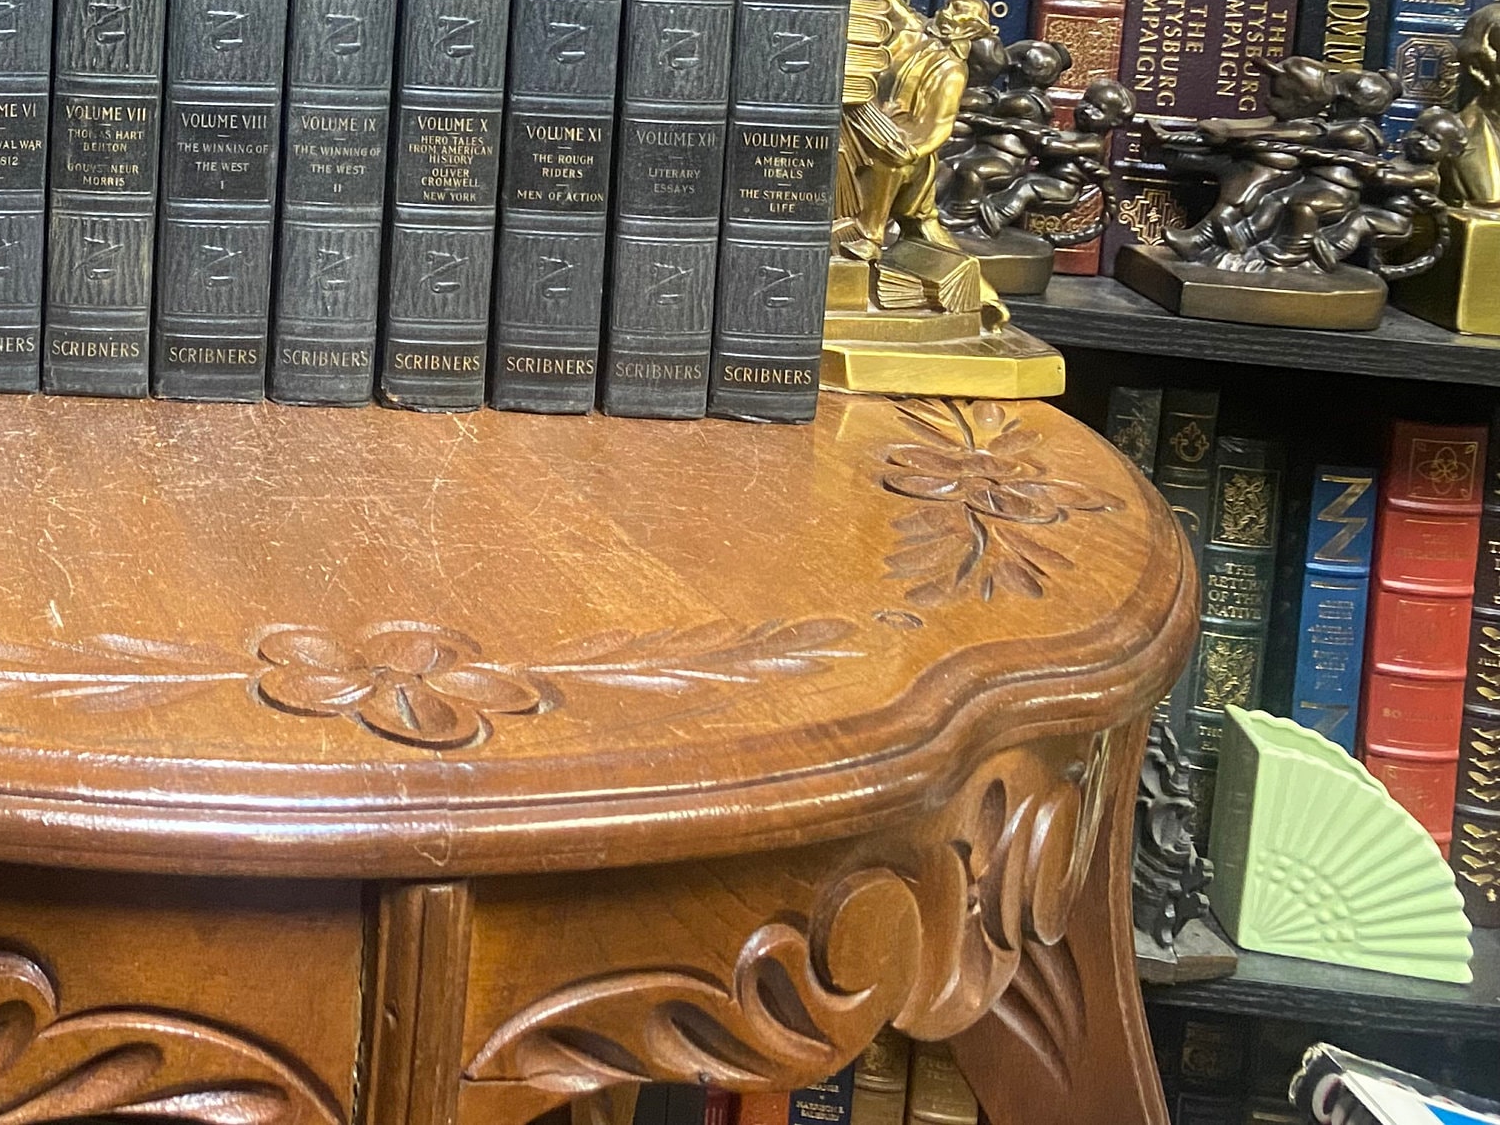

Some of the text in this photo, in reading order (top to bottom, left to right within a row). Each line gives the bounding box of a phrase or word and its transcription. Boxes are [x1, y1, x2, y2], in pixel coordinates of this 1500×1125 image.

[1185, 4, 1208, 53] THE
[1266, 10, 1288, 57] THE
[22, 103, 37, 118] VI
[19, 140, 43, 151] WAR
[742, 132, 829, 151] VOLUME XIII
[754, 156, 815, 168] AMERICAN
[763, 168, 803, 180] IDEALS
[739, 188, 827, 203] THE STRENUOUS
[769, 203, 796, 213] LIFE
[723, 364, 813, 386] SCRIBNERS
[1225, 562, 1257, 577] THE
[1207, 574, 1266, 591] RETURN
[1208, 590, 1230, 602] OF
[1207, 603, 1262, 620] NATIVE
